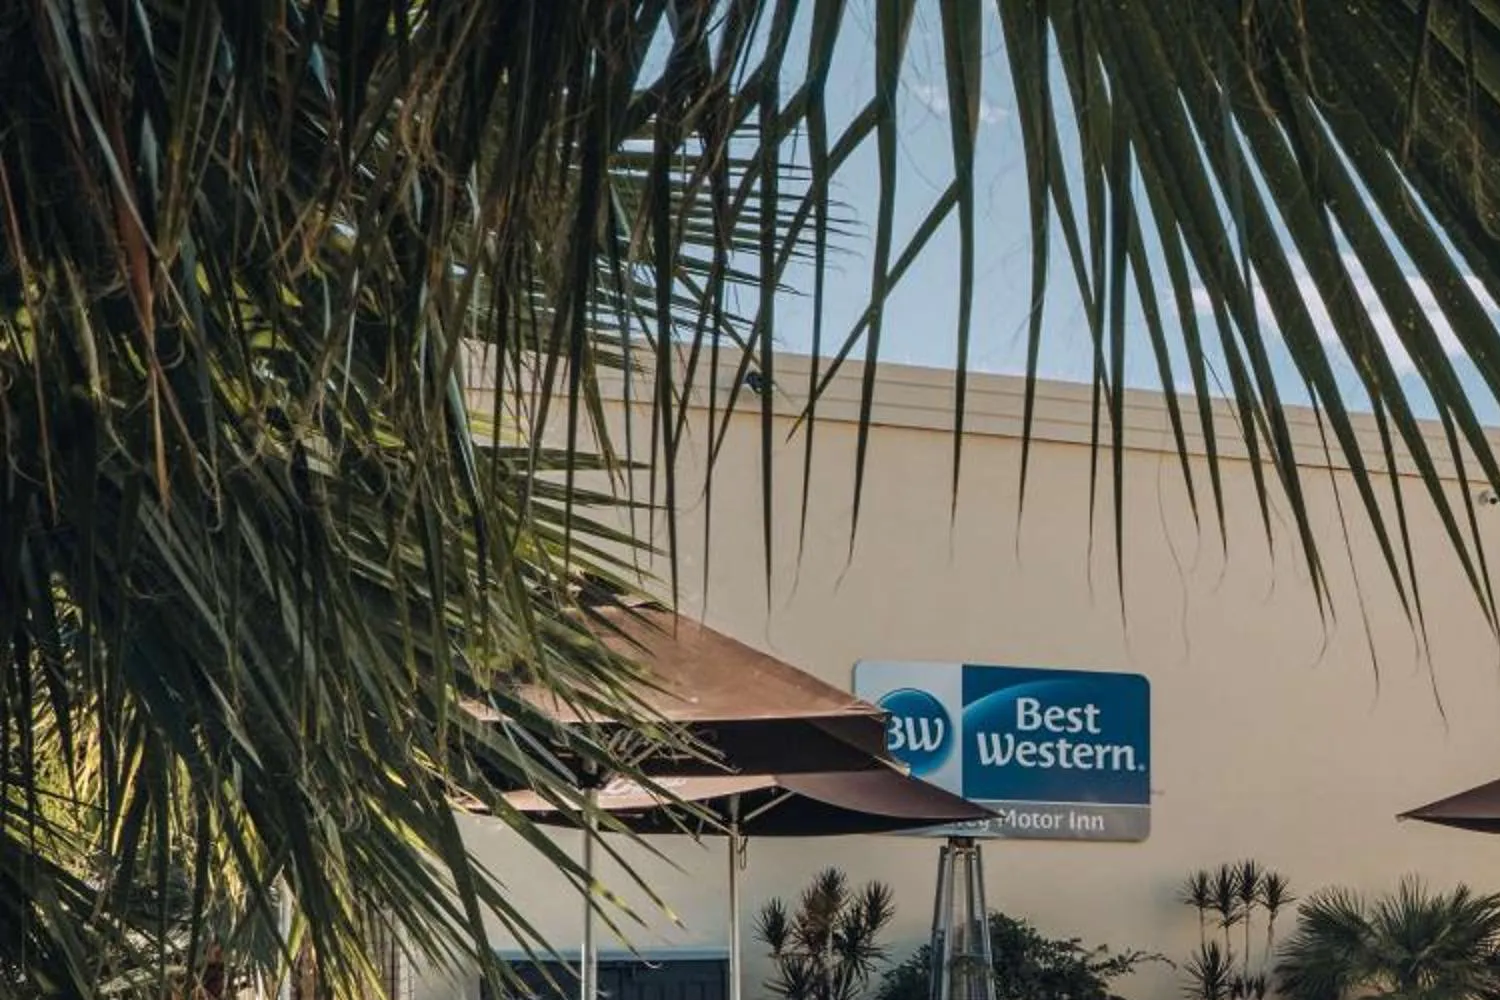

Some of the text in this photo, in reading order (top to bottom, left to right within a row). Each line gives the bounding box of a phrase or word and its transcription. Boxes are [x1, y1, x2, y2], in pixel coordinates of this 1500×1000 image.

[887, 715, 945, 752] BW
[1016, 697, 1101, 734] Best
[999, 808, 1064, 830] Motor
[1069, 810, 1105, 831] Inn
